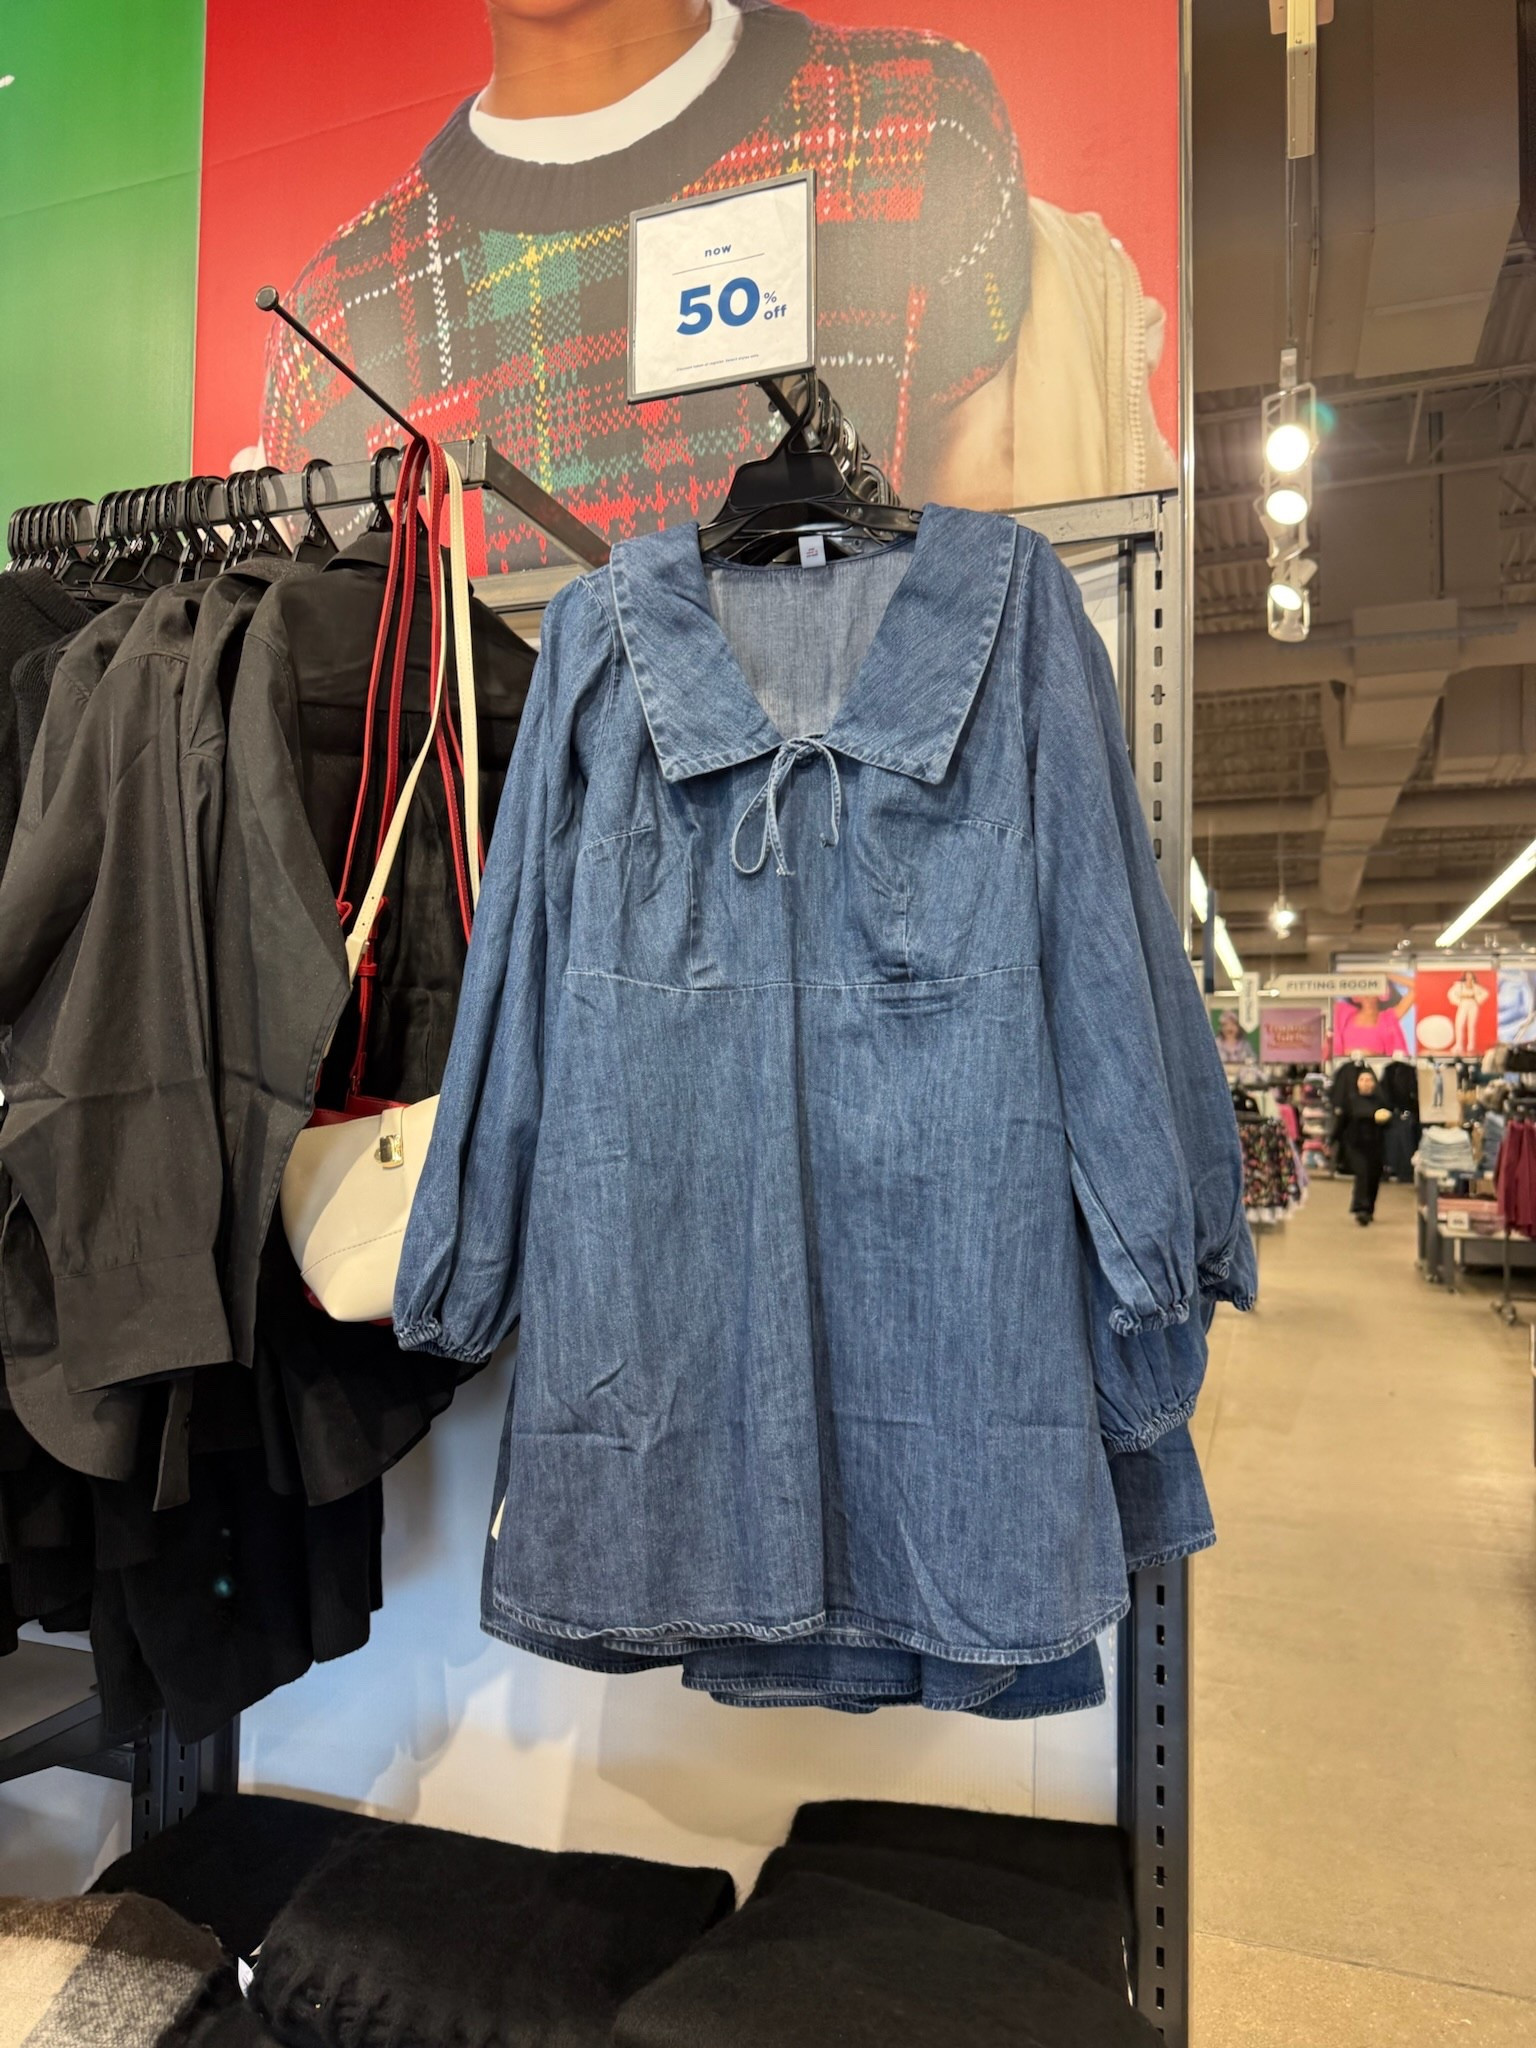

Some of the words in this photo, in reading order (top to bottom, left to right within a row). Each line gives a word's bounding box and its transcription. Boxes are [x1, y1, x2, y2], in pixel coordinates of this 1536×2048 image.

[704, 244, 732, 258] now
[764, 304, 787, 320] off
[1286, 979, 1336, 991] FITTING
[1339, 980, 1378, 990] ROOM
